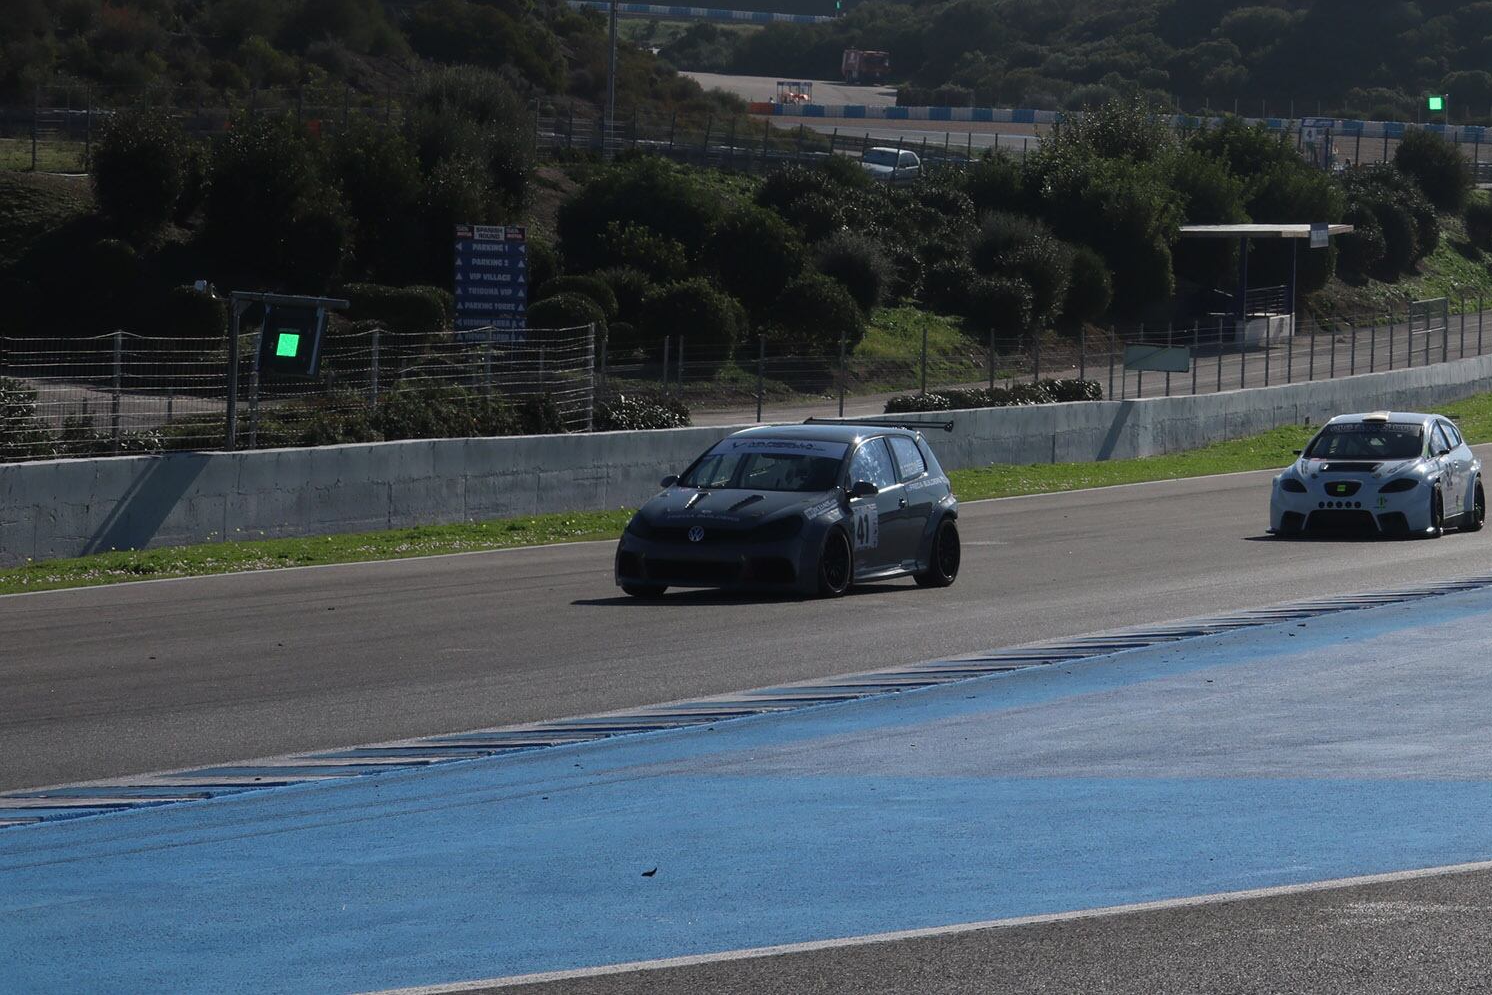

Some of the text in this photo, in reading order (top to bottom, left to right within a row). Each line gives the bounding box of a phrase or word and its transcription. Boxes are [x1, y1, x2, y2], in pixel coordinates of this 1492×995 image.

[472, 244, 503, 252] PARKING
[471, 258, 503, 266] PARKING
[469, 272, 511, 281] VIP VILLAGE
[500, 288, 513, 296] VIP
[464, 302, 493, 310] PARKING
[856, 514, 869, 545] 41
